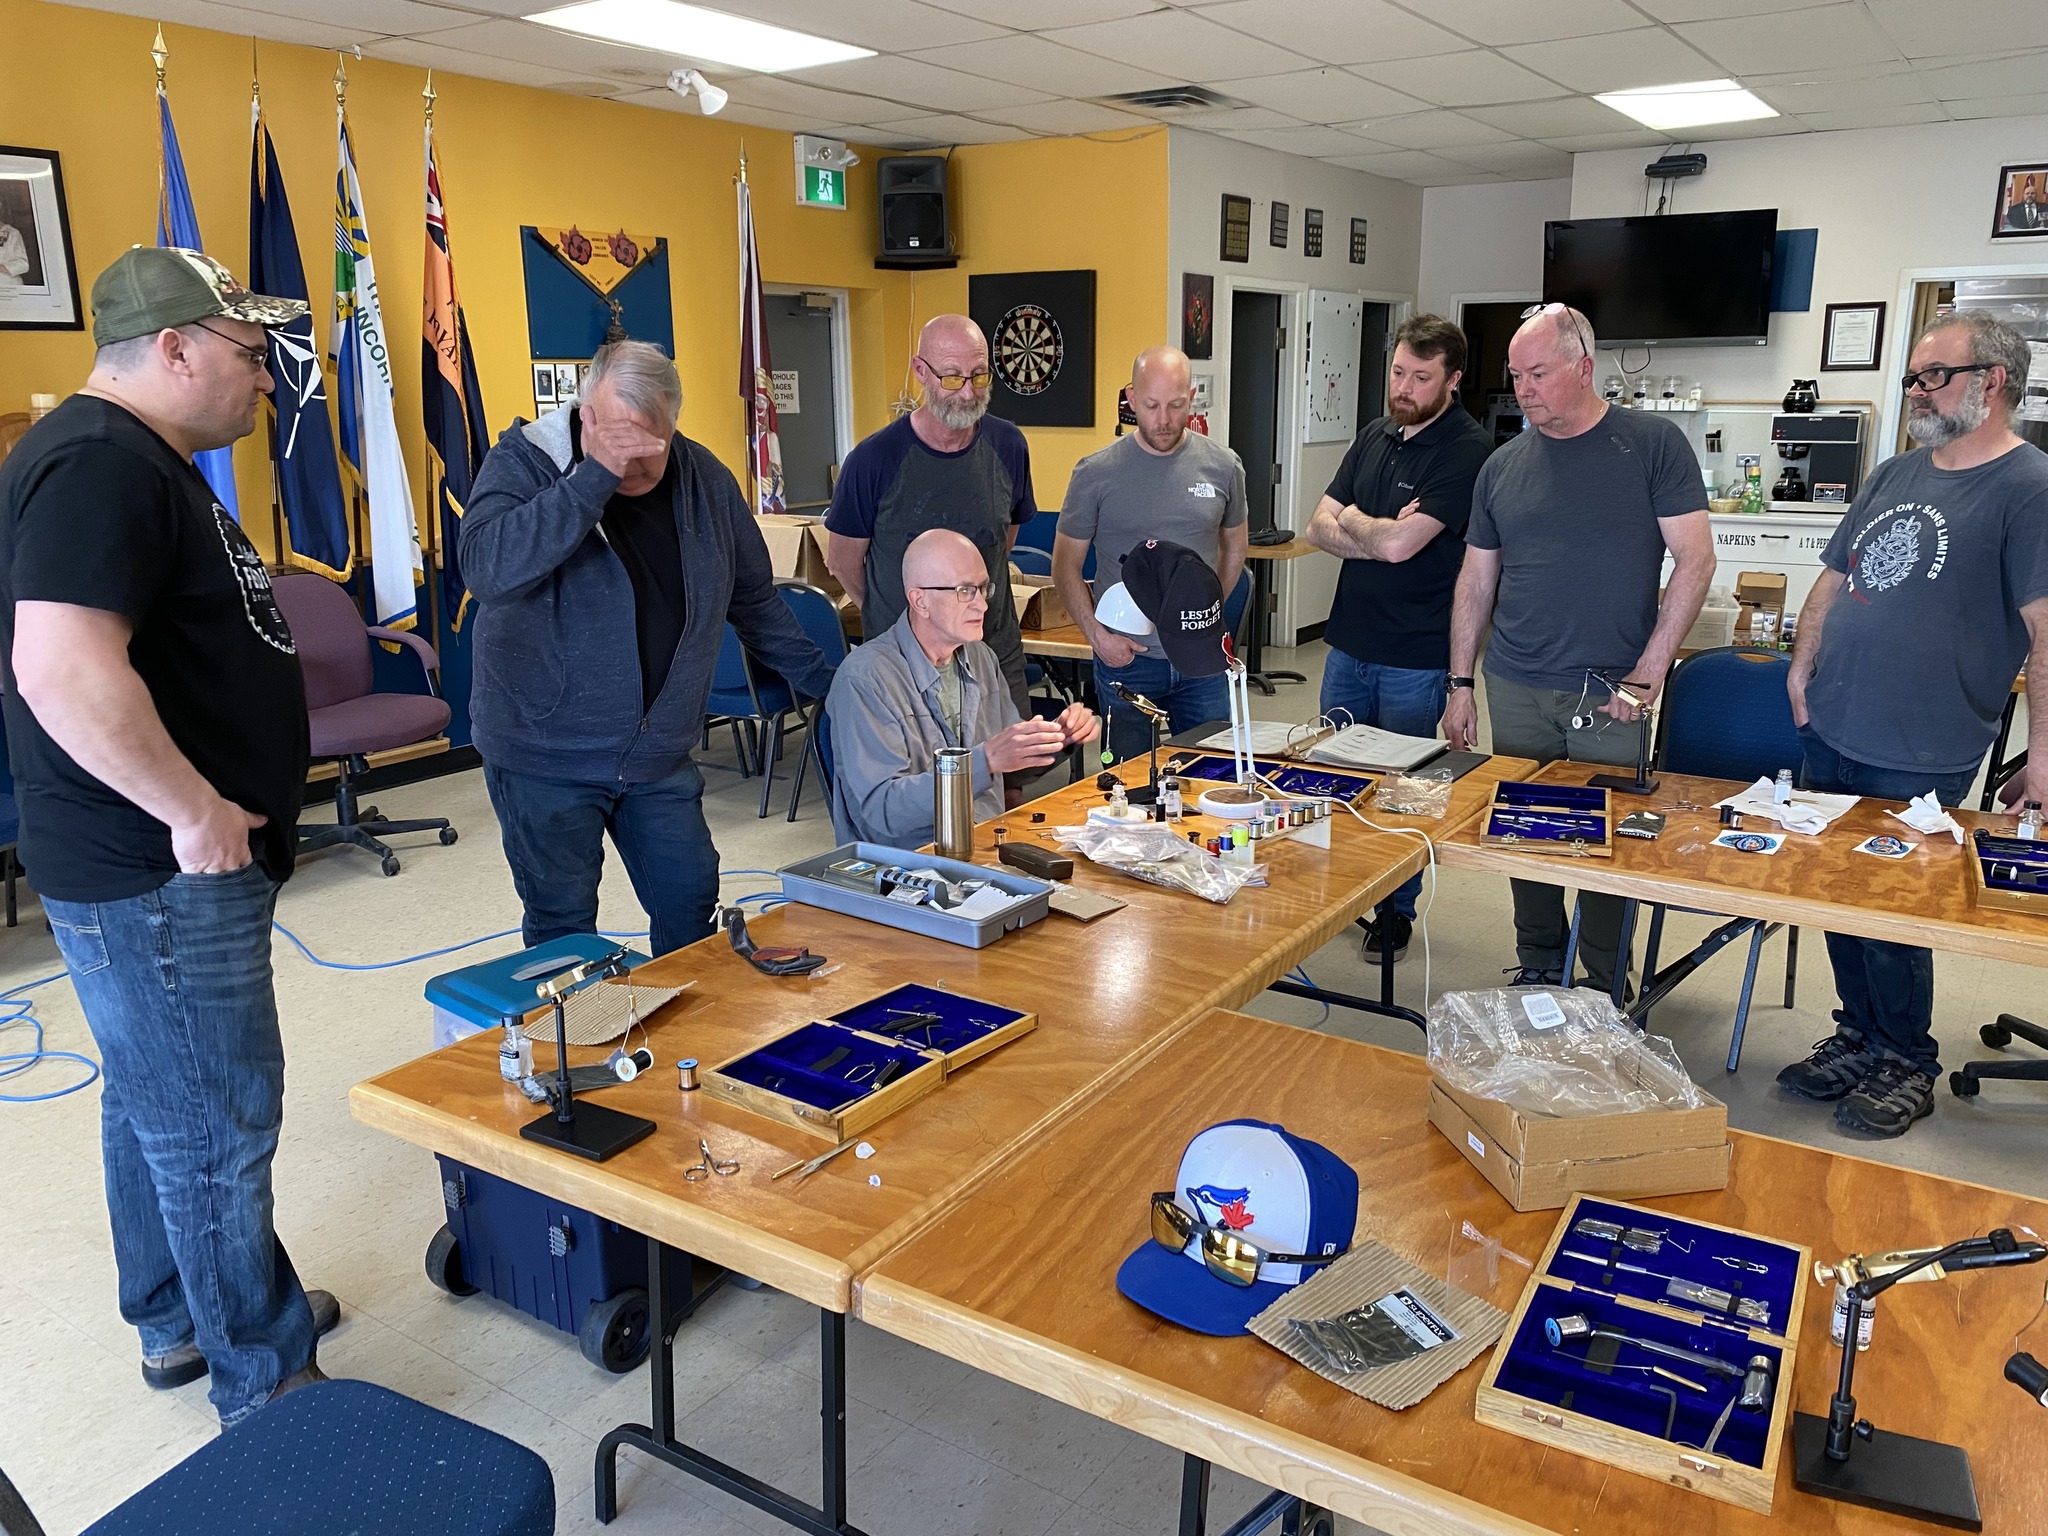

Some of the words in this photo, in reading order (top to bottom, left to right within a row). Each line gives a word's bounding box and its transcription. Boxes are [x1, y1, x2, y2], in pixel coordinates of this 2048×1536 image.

[1896, 503, 1915, 513] ON
[1922, 504, 1946, 528] SANS
[1717, 534, 1756, 546] NAPKINS
[1852, 509, 1894, 550] SOLDIER
[1927, 528, 1949, 580] LIMITES
[1180, 608, 1211, 620] LEST
[1211, 600, 1221, 614] WE
[1181, 610, 1221, 631] FORGET
